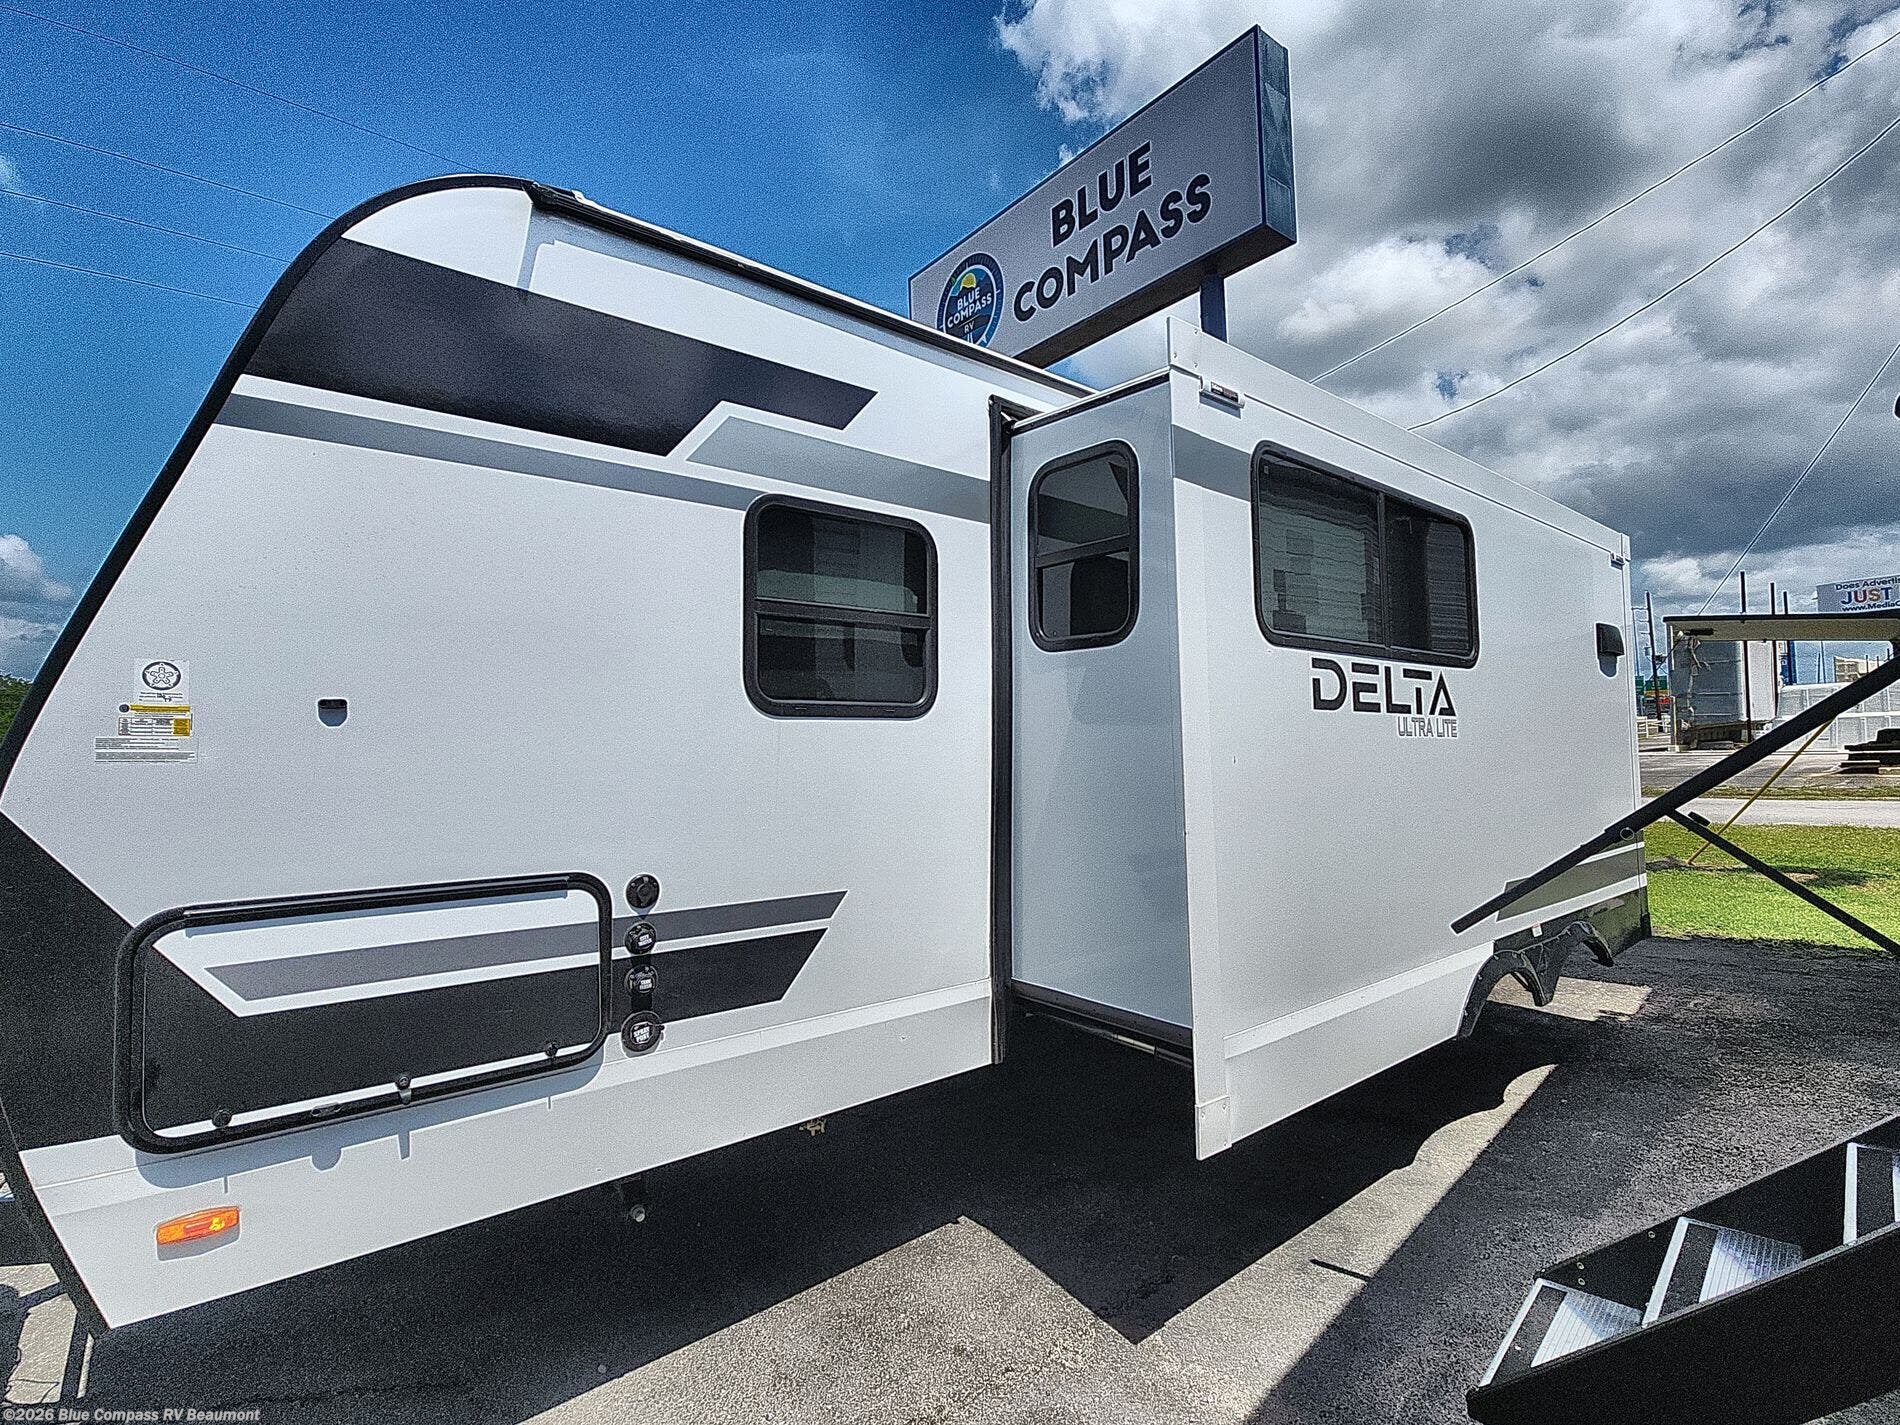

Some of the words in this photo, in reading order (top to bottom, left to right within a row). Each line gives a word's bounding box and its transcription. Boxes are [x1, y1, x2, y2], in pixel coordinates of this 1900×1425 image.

[1052, 140, 1152, 248] BLUE
[1013, 174, 1212, 322] COMPASS
[947, 292, 992, 328] COMPASS
[957, 287, 980, 311] BLUE
[964, 320, 975, 333] RV
[1835, 582, 1860, 591] Does
[1841, 587, 1893, 604] JUST
[1311, 657, 1457, 716] DELTA
[1397, 716, 1434, 737] ULTRA
[1436, 718, 1458, 738] LITE
